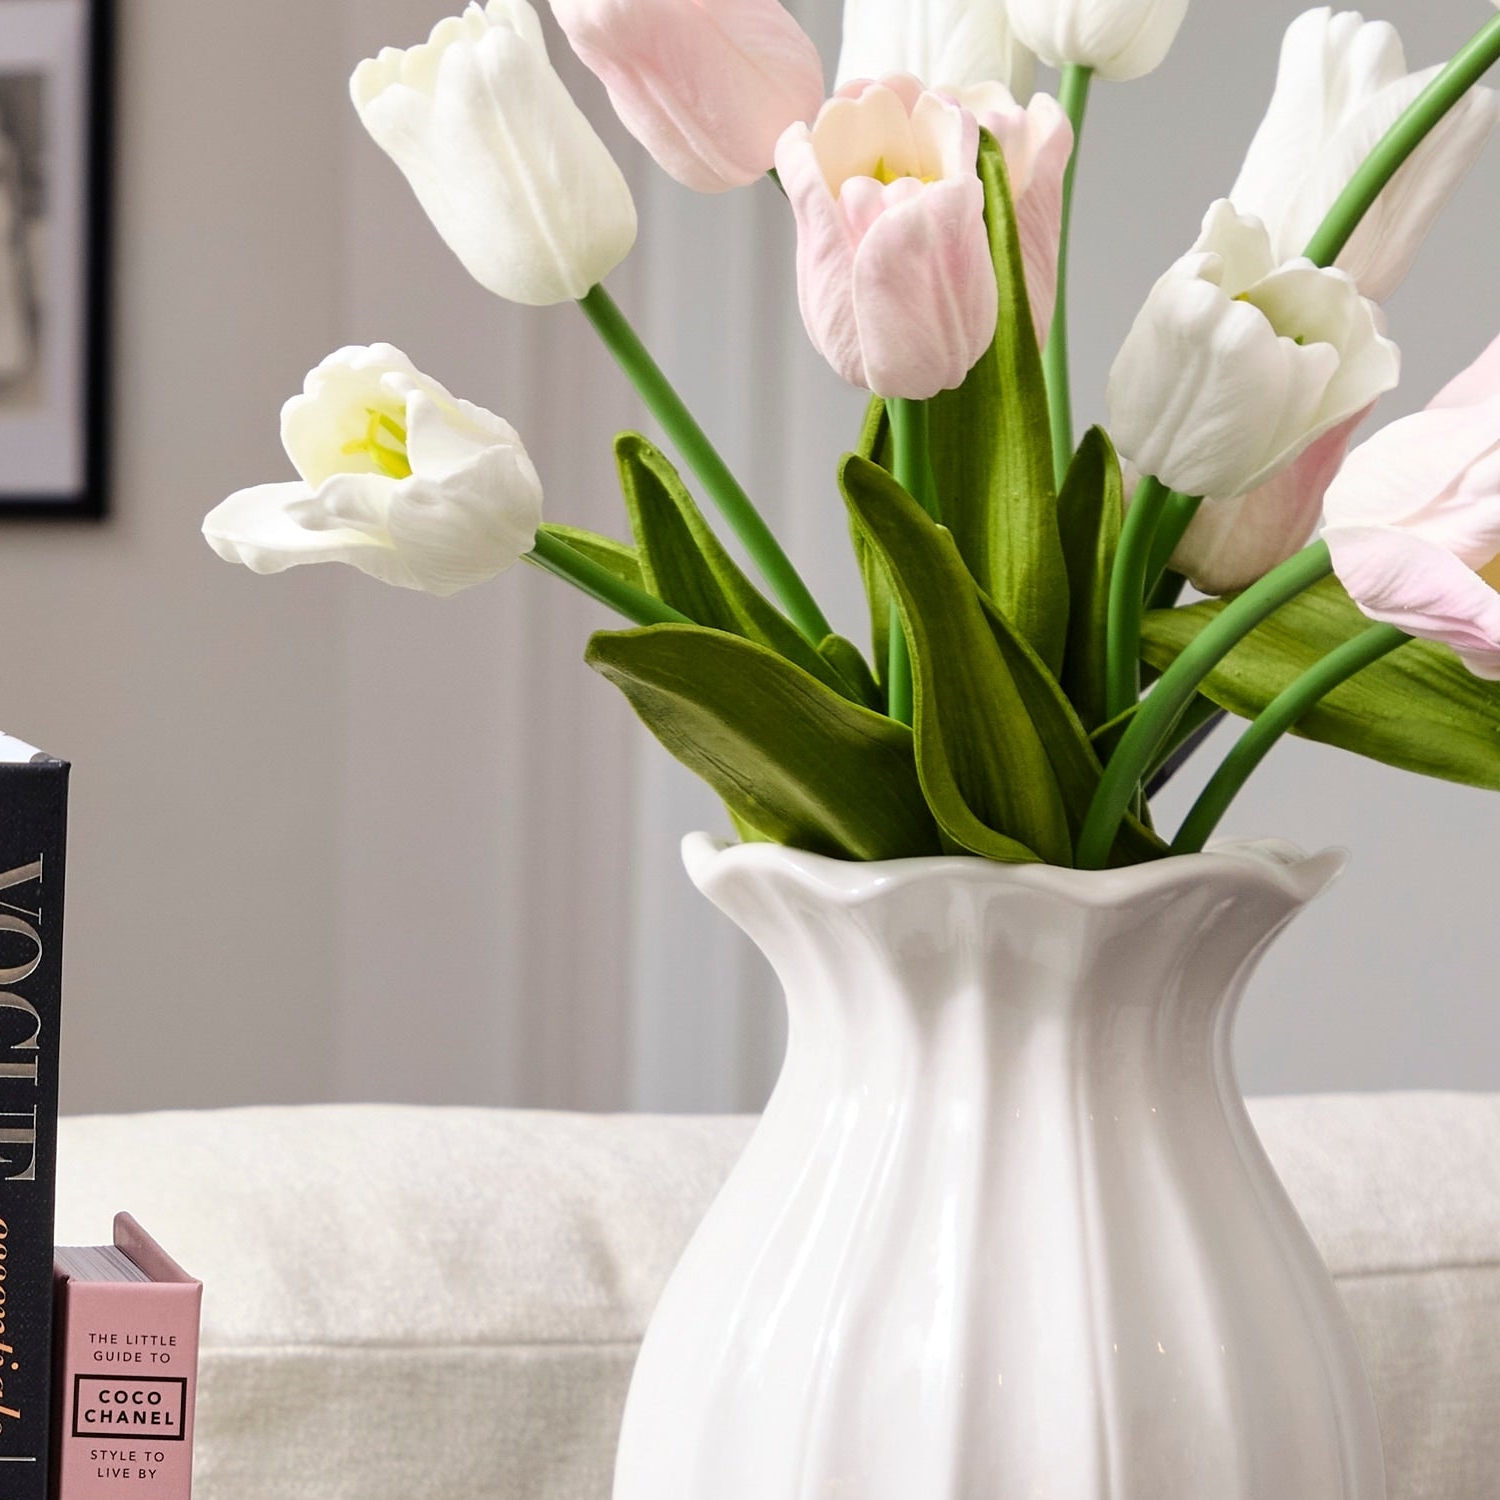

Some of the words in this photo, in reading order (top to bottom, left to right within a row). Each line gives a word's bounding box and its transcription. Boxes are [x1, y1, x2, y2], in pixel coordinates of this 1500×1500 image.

[88, 1332, 118, 1345] THE
[126, 1334, 177, 1347] LITTLE
[93, 1350, 143, 1363] GUIDE
[150, 1352, 171, 1364] TO
[98, 1389, 162, 1406] COCO
[84, 1408, 174, 1426] CHANEL
[90, 1449, 136, 1462] STYLE
[145, 1451, 165, 1463] TO
[97, 1467, 130, 1479] LIVE
[138, 1468, 157, 1479] BY
